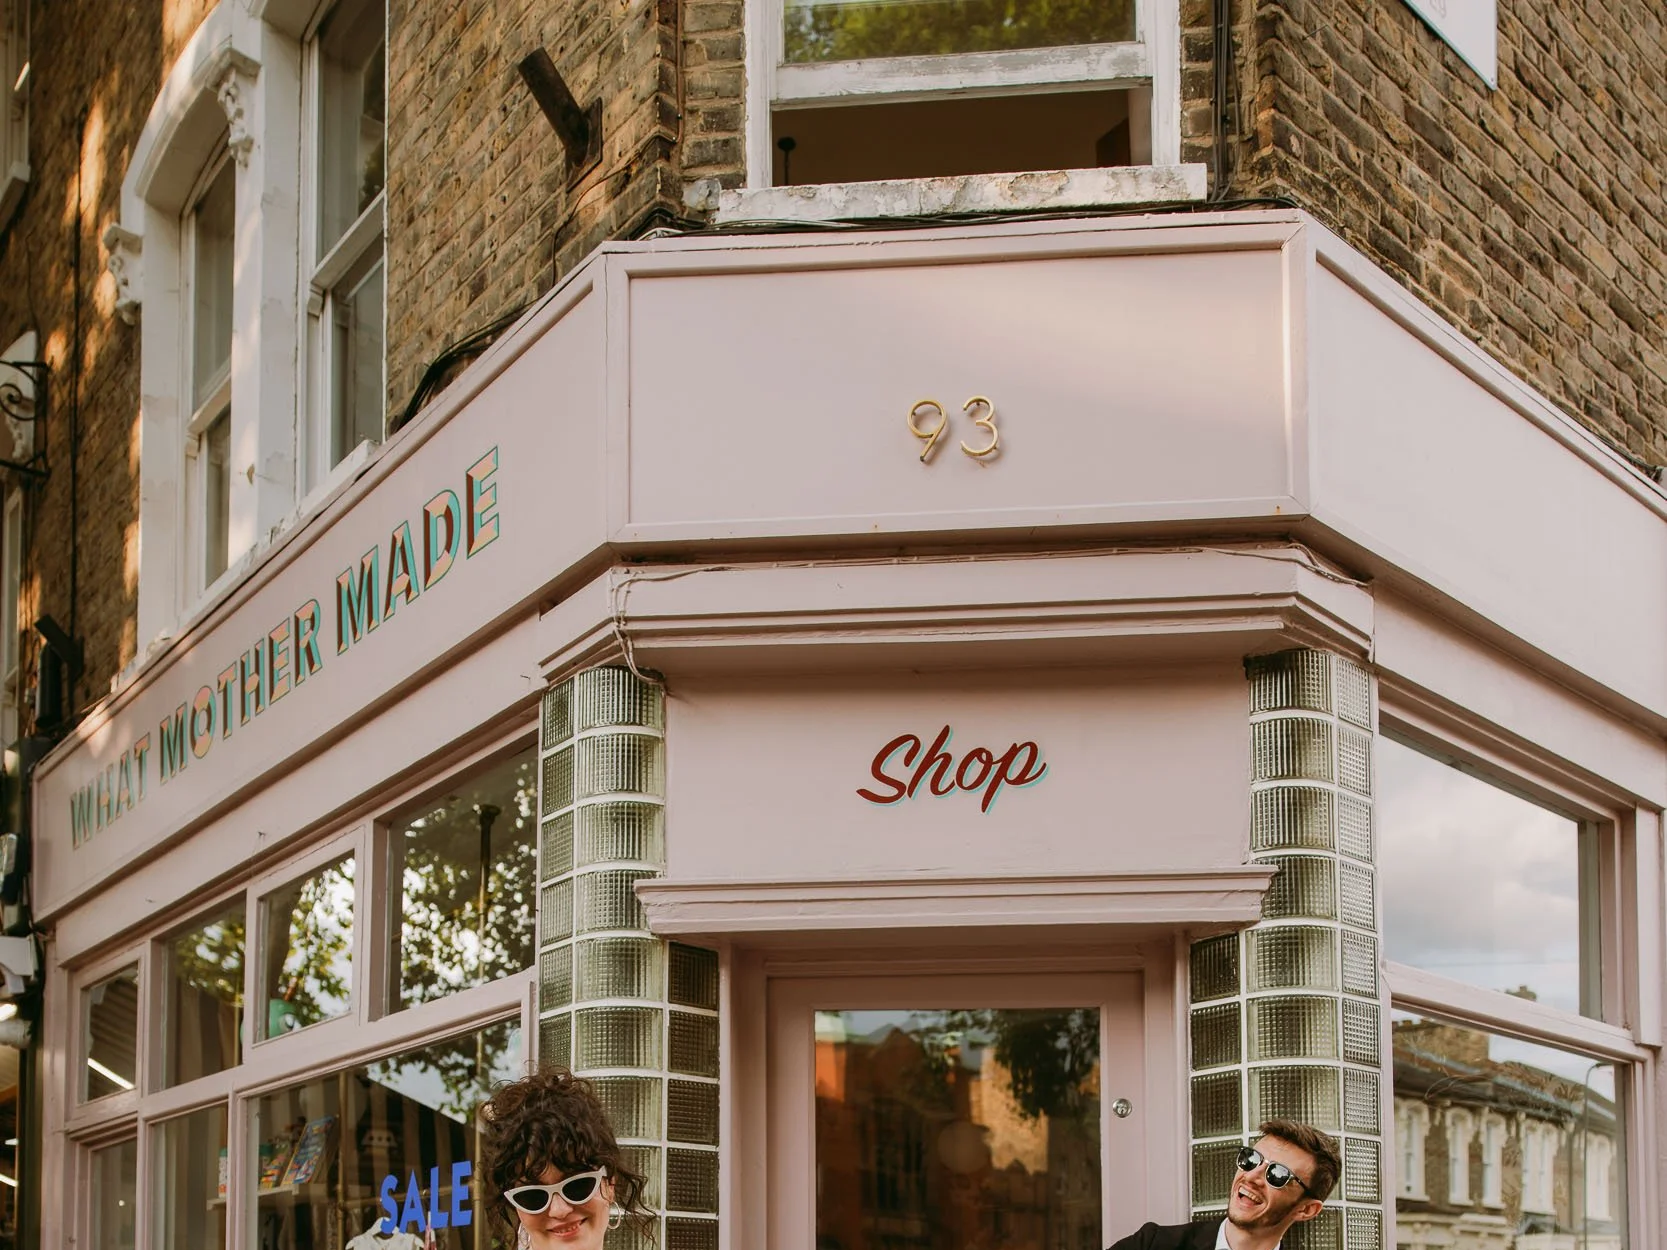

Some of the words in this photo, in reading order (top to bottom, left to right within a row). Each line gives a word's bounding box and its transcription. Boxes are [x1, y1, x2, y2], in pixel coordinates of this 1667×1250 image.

[906, 395, 1000, 463] 93
[70, 732, 151, 851] WHAT
[159, 598, 323, 786] MOTHER
[336, 445, 500, 656] MADE
[856, 724, 1048, 815] Shop
[380, 1160, 473, 1235] SALE
